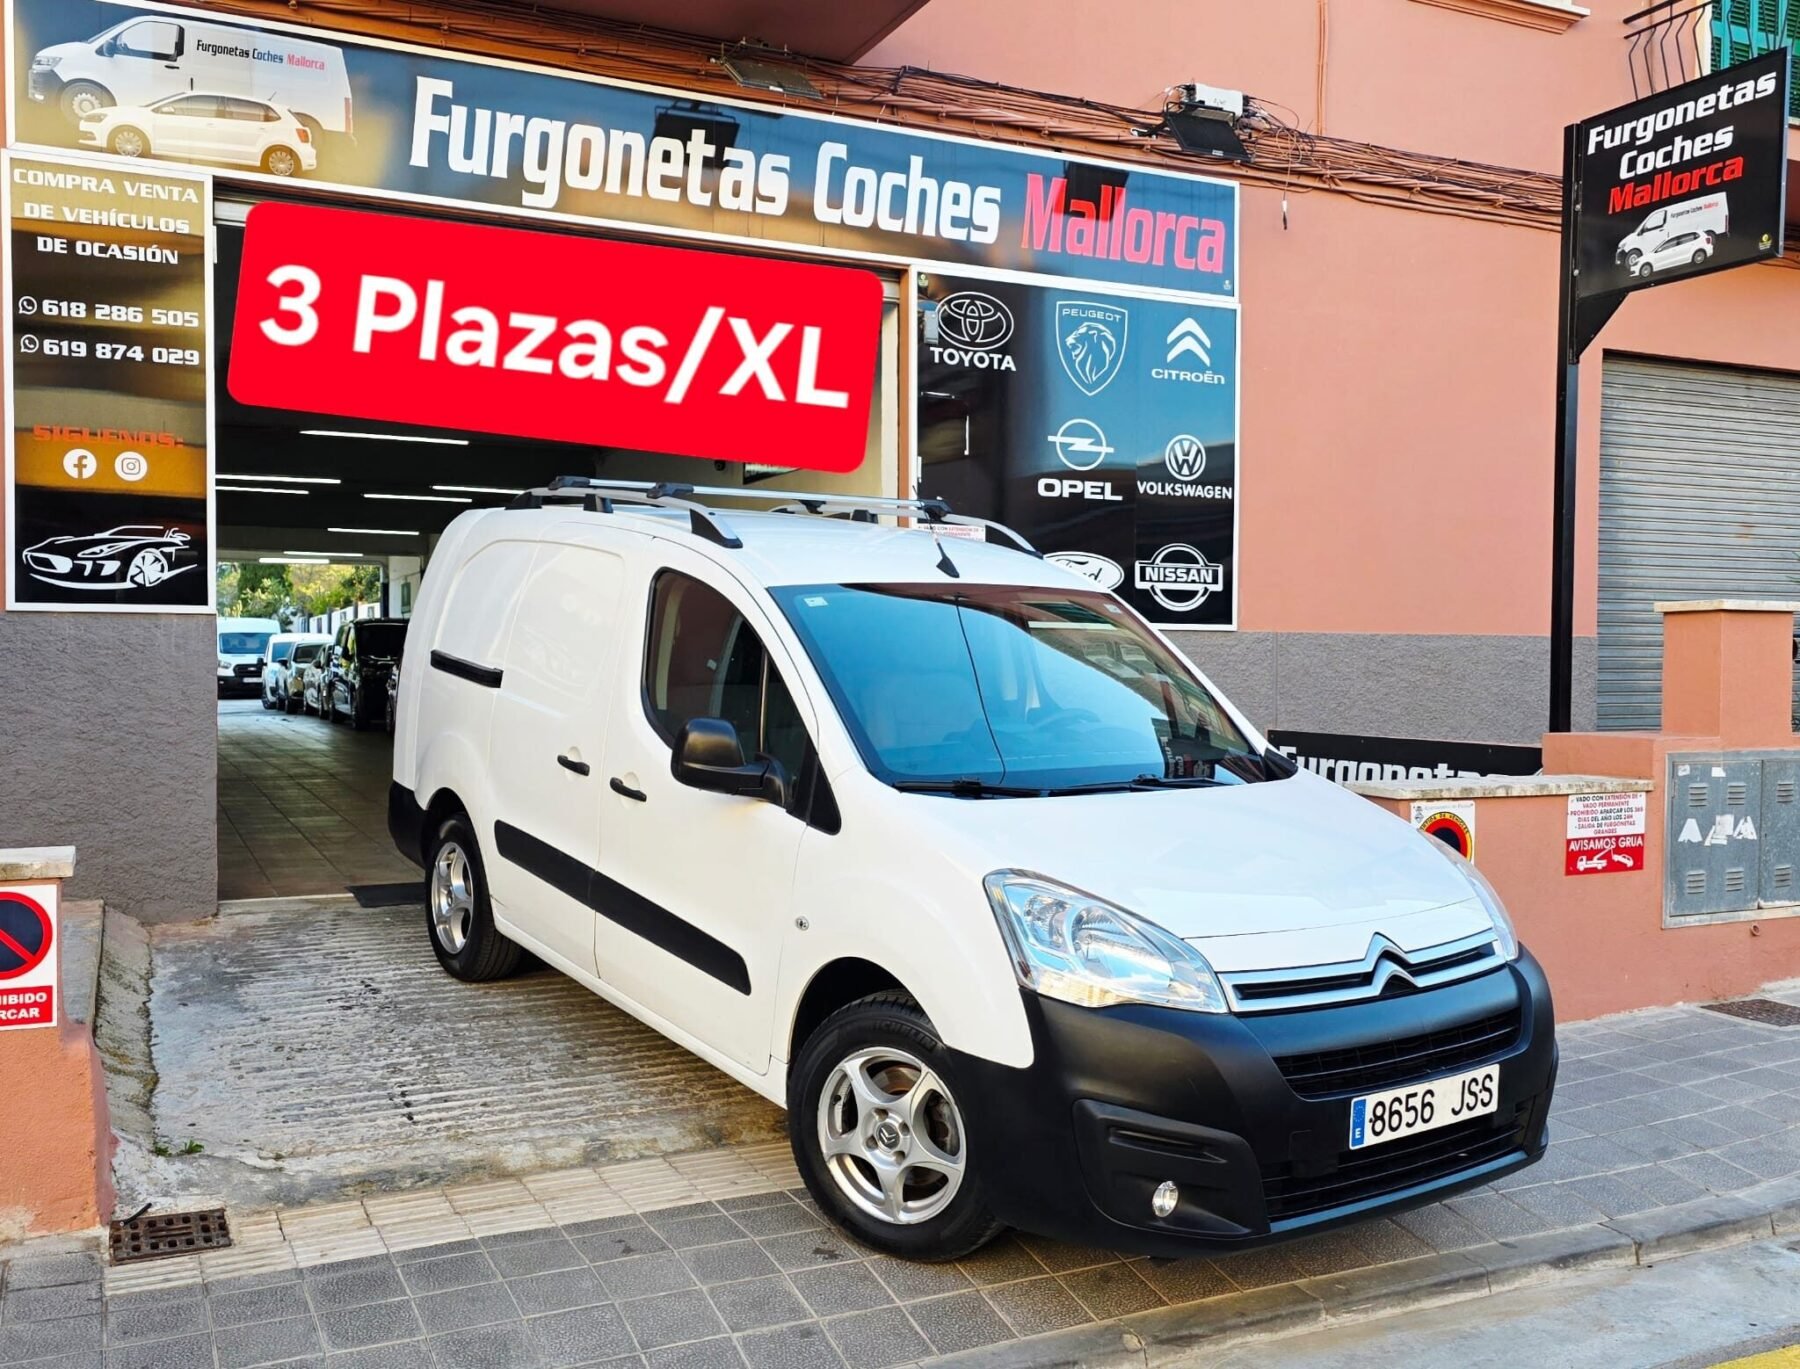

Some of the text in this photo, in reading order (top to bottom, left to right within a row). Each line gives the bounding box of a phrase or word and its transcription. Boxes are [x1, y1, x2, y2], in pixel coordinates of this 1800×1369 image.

[197, 40, 324, 70] Furgonetas Coches Mallorca
[1587, 71, 1777, 155] Furgonetas
[1619, 125, 1734, 180] Coches
[13, 169, 199, 203] COMPRA VENTA
[410, 76, 1225, 273] Furgonetas Coches Mallorca
[1608, 156, 1744, 215] Mallorca
[24, 202, 190, 234] DE VEHÍCULOS
[37, 236, 178, 264] DE OCASIÓN
[42, 299, 199, 327] 618 286 505
[1062, 308, 1122, 323] PEUGEOT
[43, 339, 199, 366] 619 874 029
[930, 347, 1016, 372] TOYOTA
[1037, 478, 1123, 501] OPEL
[1137, 480, 1232, 500] VOLKSWAGEN
[1146, 566, 1213, 584] NISSAN
[1569, 835, 1643, 852] AVISAMOS GRUA
[1354, 1073, 1494, 1139] E 8656 JSS
